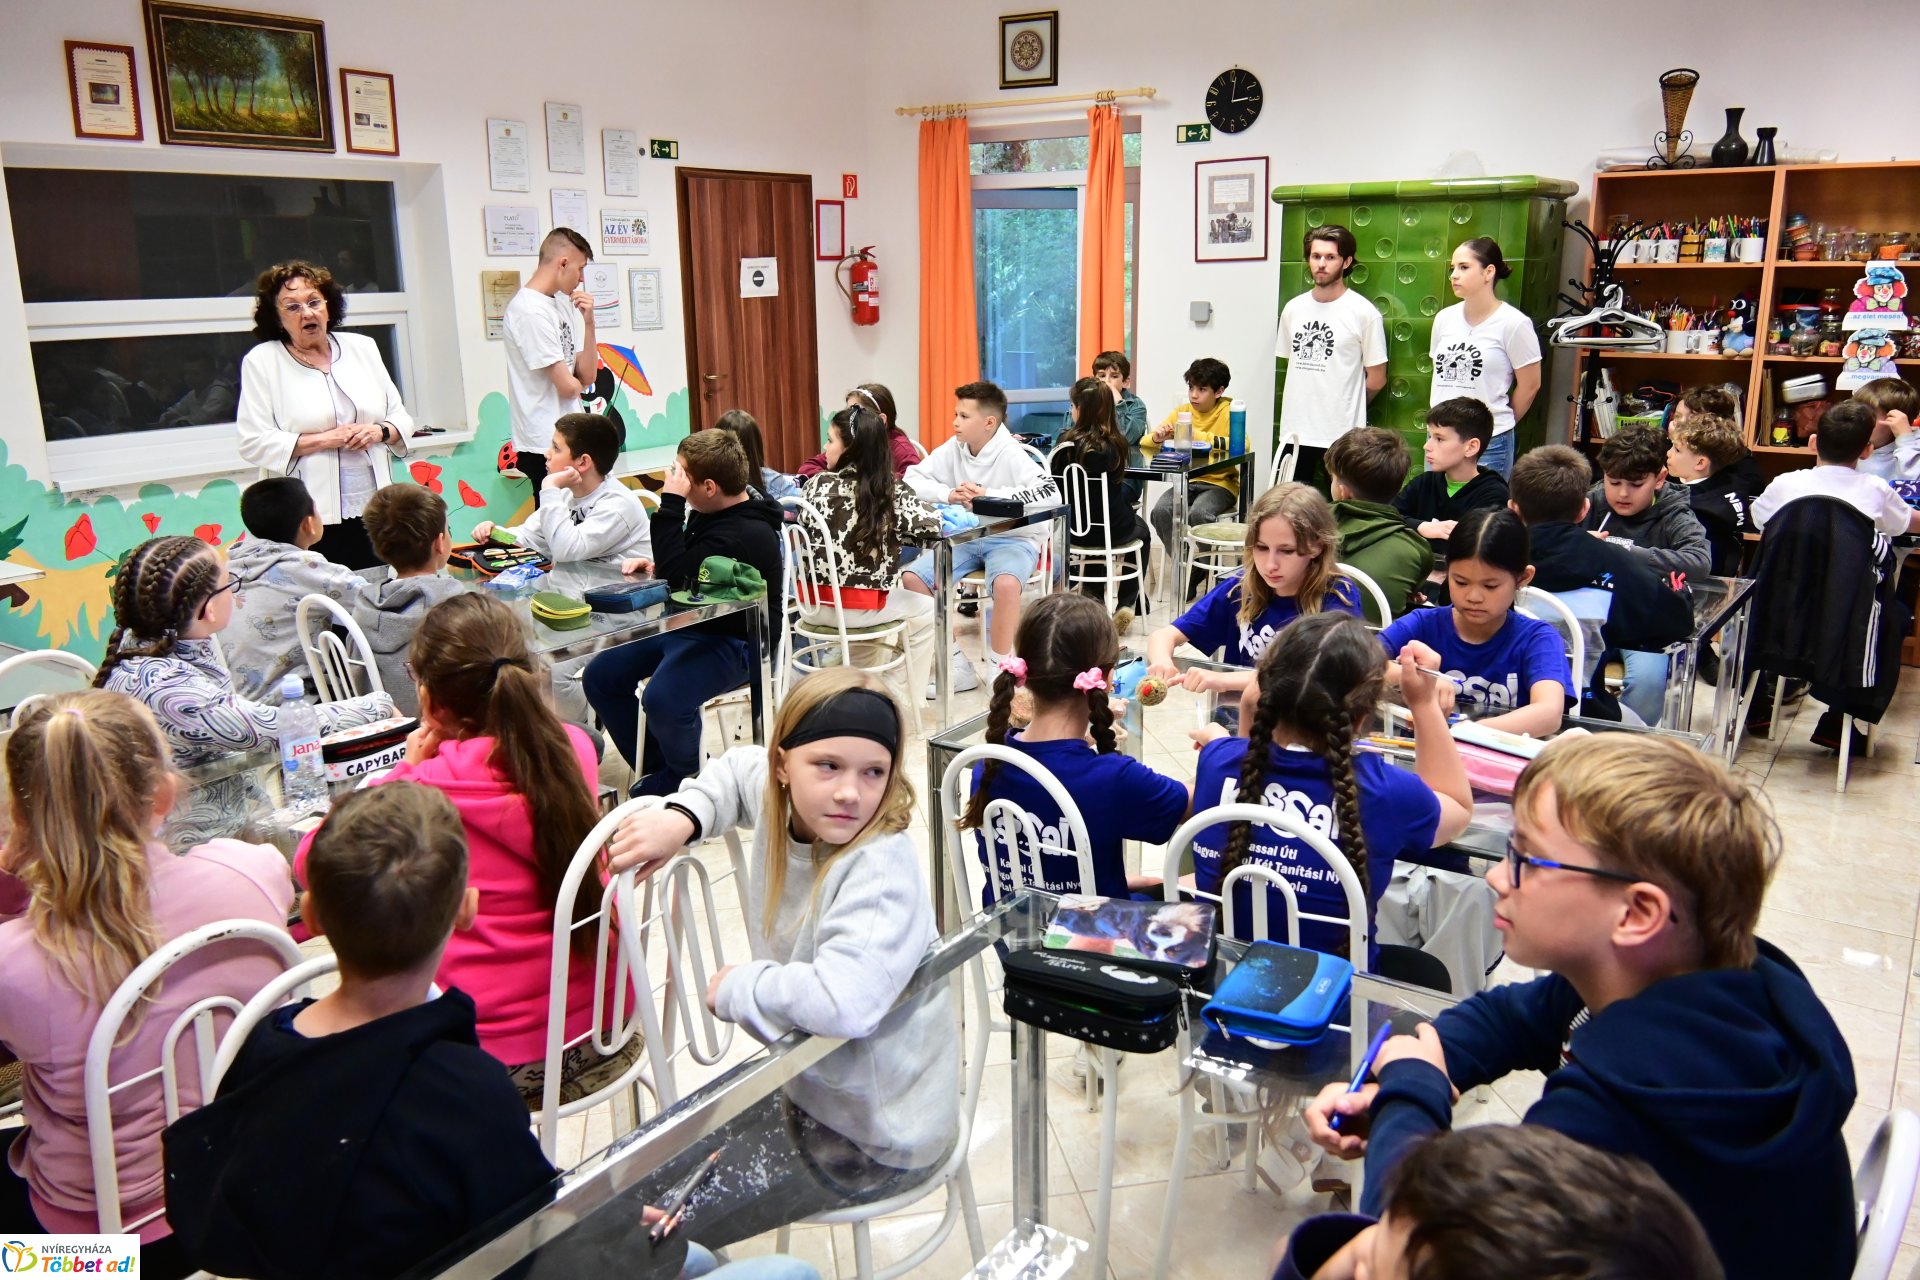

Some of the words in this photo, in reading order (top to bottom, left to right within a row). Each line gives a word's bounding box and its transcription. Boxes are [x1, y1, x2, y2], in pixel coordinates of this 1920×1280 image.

[604, 224, 617, 235] AZ
[617, 217, 629, 235] ÉV
[1292, 332, 1303, 353] KIS
[1435, 353, 1445, 375] KIS
[292, 740, 320, 757] Jana
[1279, 845, 1298, 861] Úti
